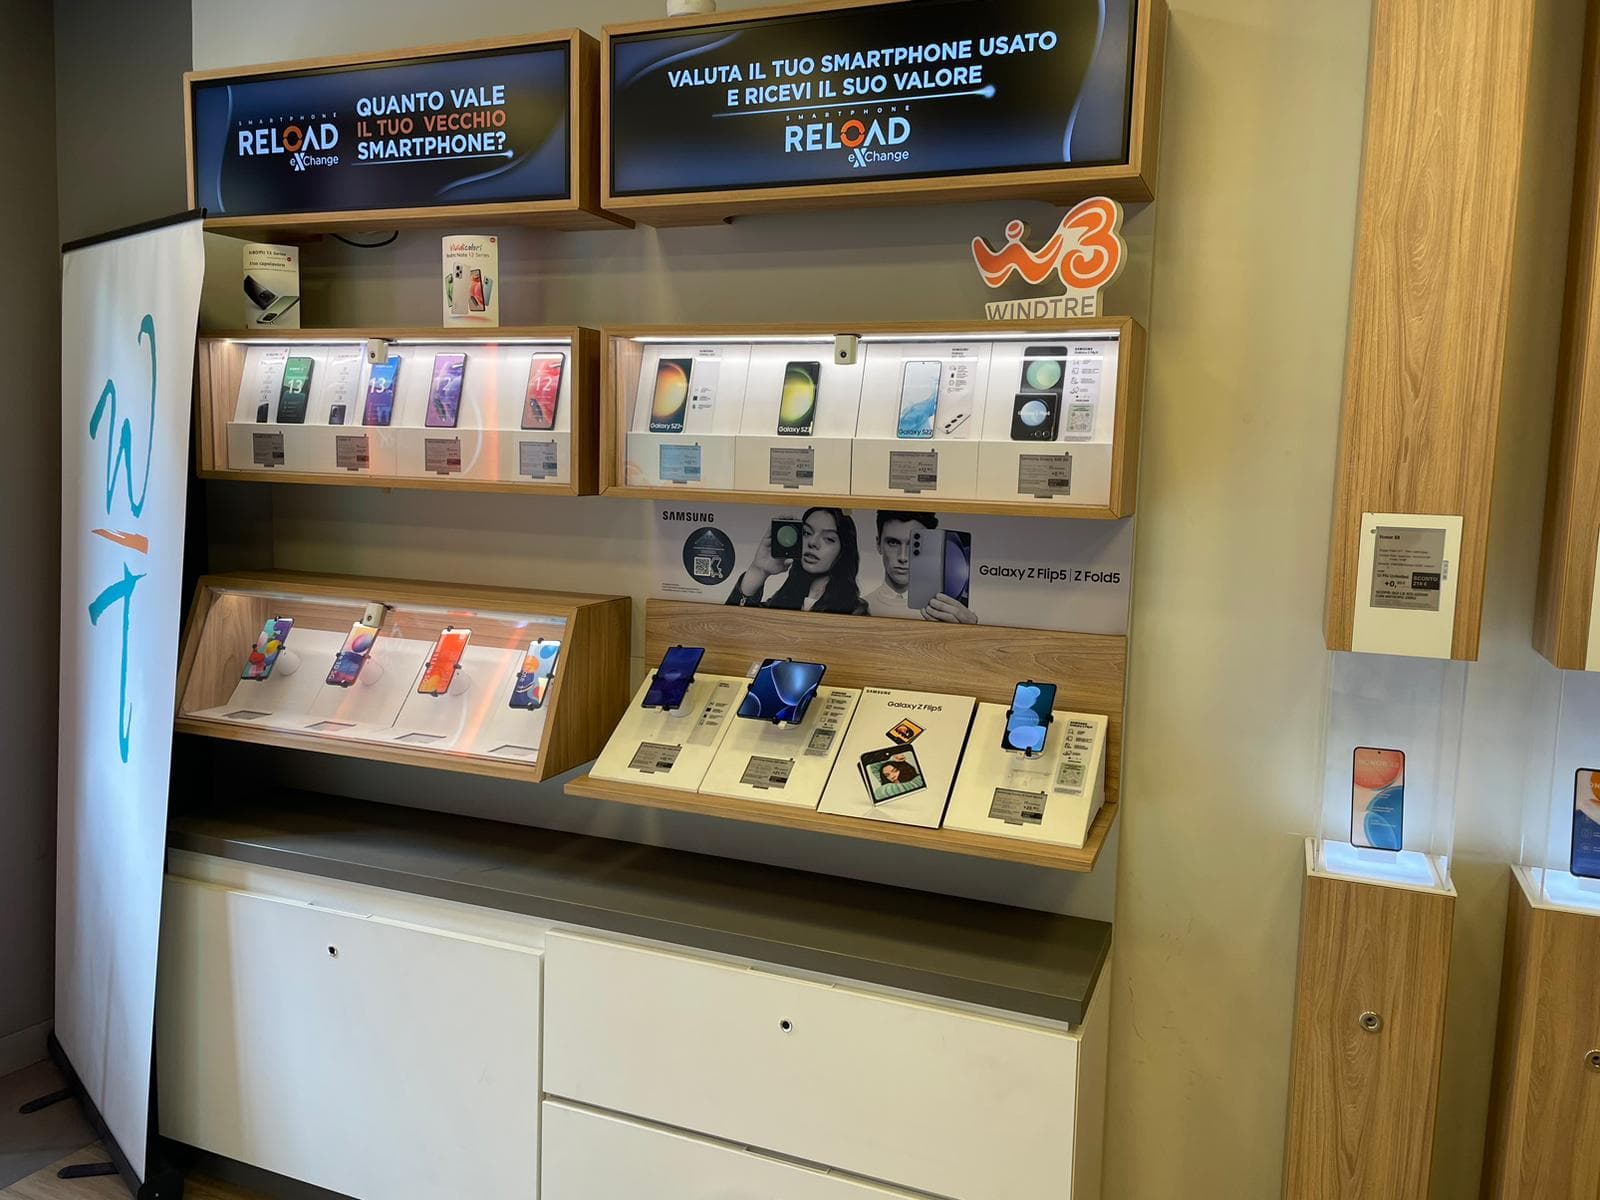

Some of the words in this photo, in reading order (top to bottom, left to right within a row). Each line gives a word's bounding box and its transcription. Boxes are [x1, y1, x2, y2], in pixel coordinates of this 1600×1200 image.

[667, 66, 743, 88] VALUTA
[749, 63, 766, 80] IL
[772, 58, 814, 78] TUO
[821, 39, 972, 73] SMARTPHONE
[979, 30, 1057, 56] USATO
[727, 89, 739, 106] E
[744, 82, 811, 105] RICEVI
[818, 81, 837, 98] IL
[842, 74, 885, 96] SUO
[893, 65, 982, 91] VALORE
[356, 91, 444, 118] QUANTO
[450, 84, 505, 107] VALE
[357, 120, 372, 138] IL
[377, 118, 414, 137] TUO
[423, 109, 506, 133] VECCHIO
[238, 123, 339, 156] RELOAD
[784, 116, 911, 153] RELOAD
[357, 131, 506, 161] SMARTPHONE?
[987, 296, 1094, 320] WINDTRE
[288, 379, 303, 394] 13
[369, 377, 386, 394] 13
[535, 376, 553, 392] 12
[779, 426, 800, 434] Galaxy
[899, 428, 920, 437] Galaxy
[662, 511, 714, 522] SAMSUNG
[979, 565, 1026, 580] Galaxy
[1027, 567, 1035, 579] Z
[1037, 567, 1067, 583] Flip5
[1074, 570, 1082, 582] Z
[1084, 571, 1121, 584] Fold5
[887, 701, 917, 710] Galaxy
[923, 704, 943, 712] Flip5
